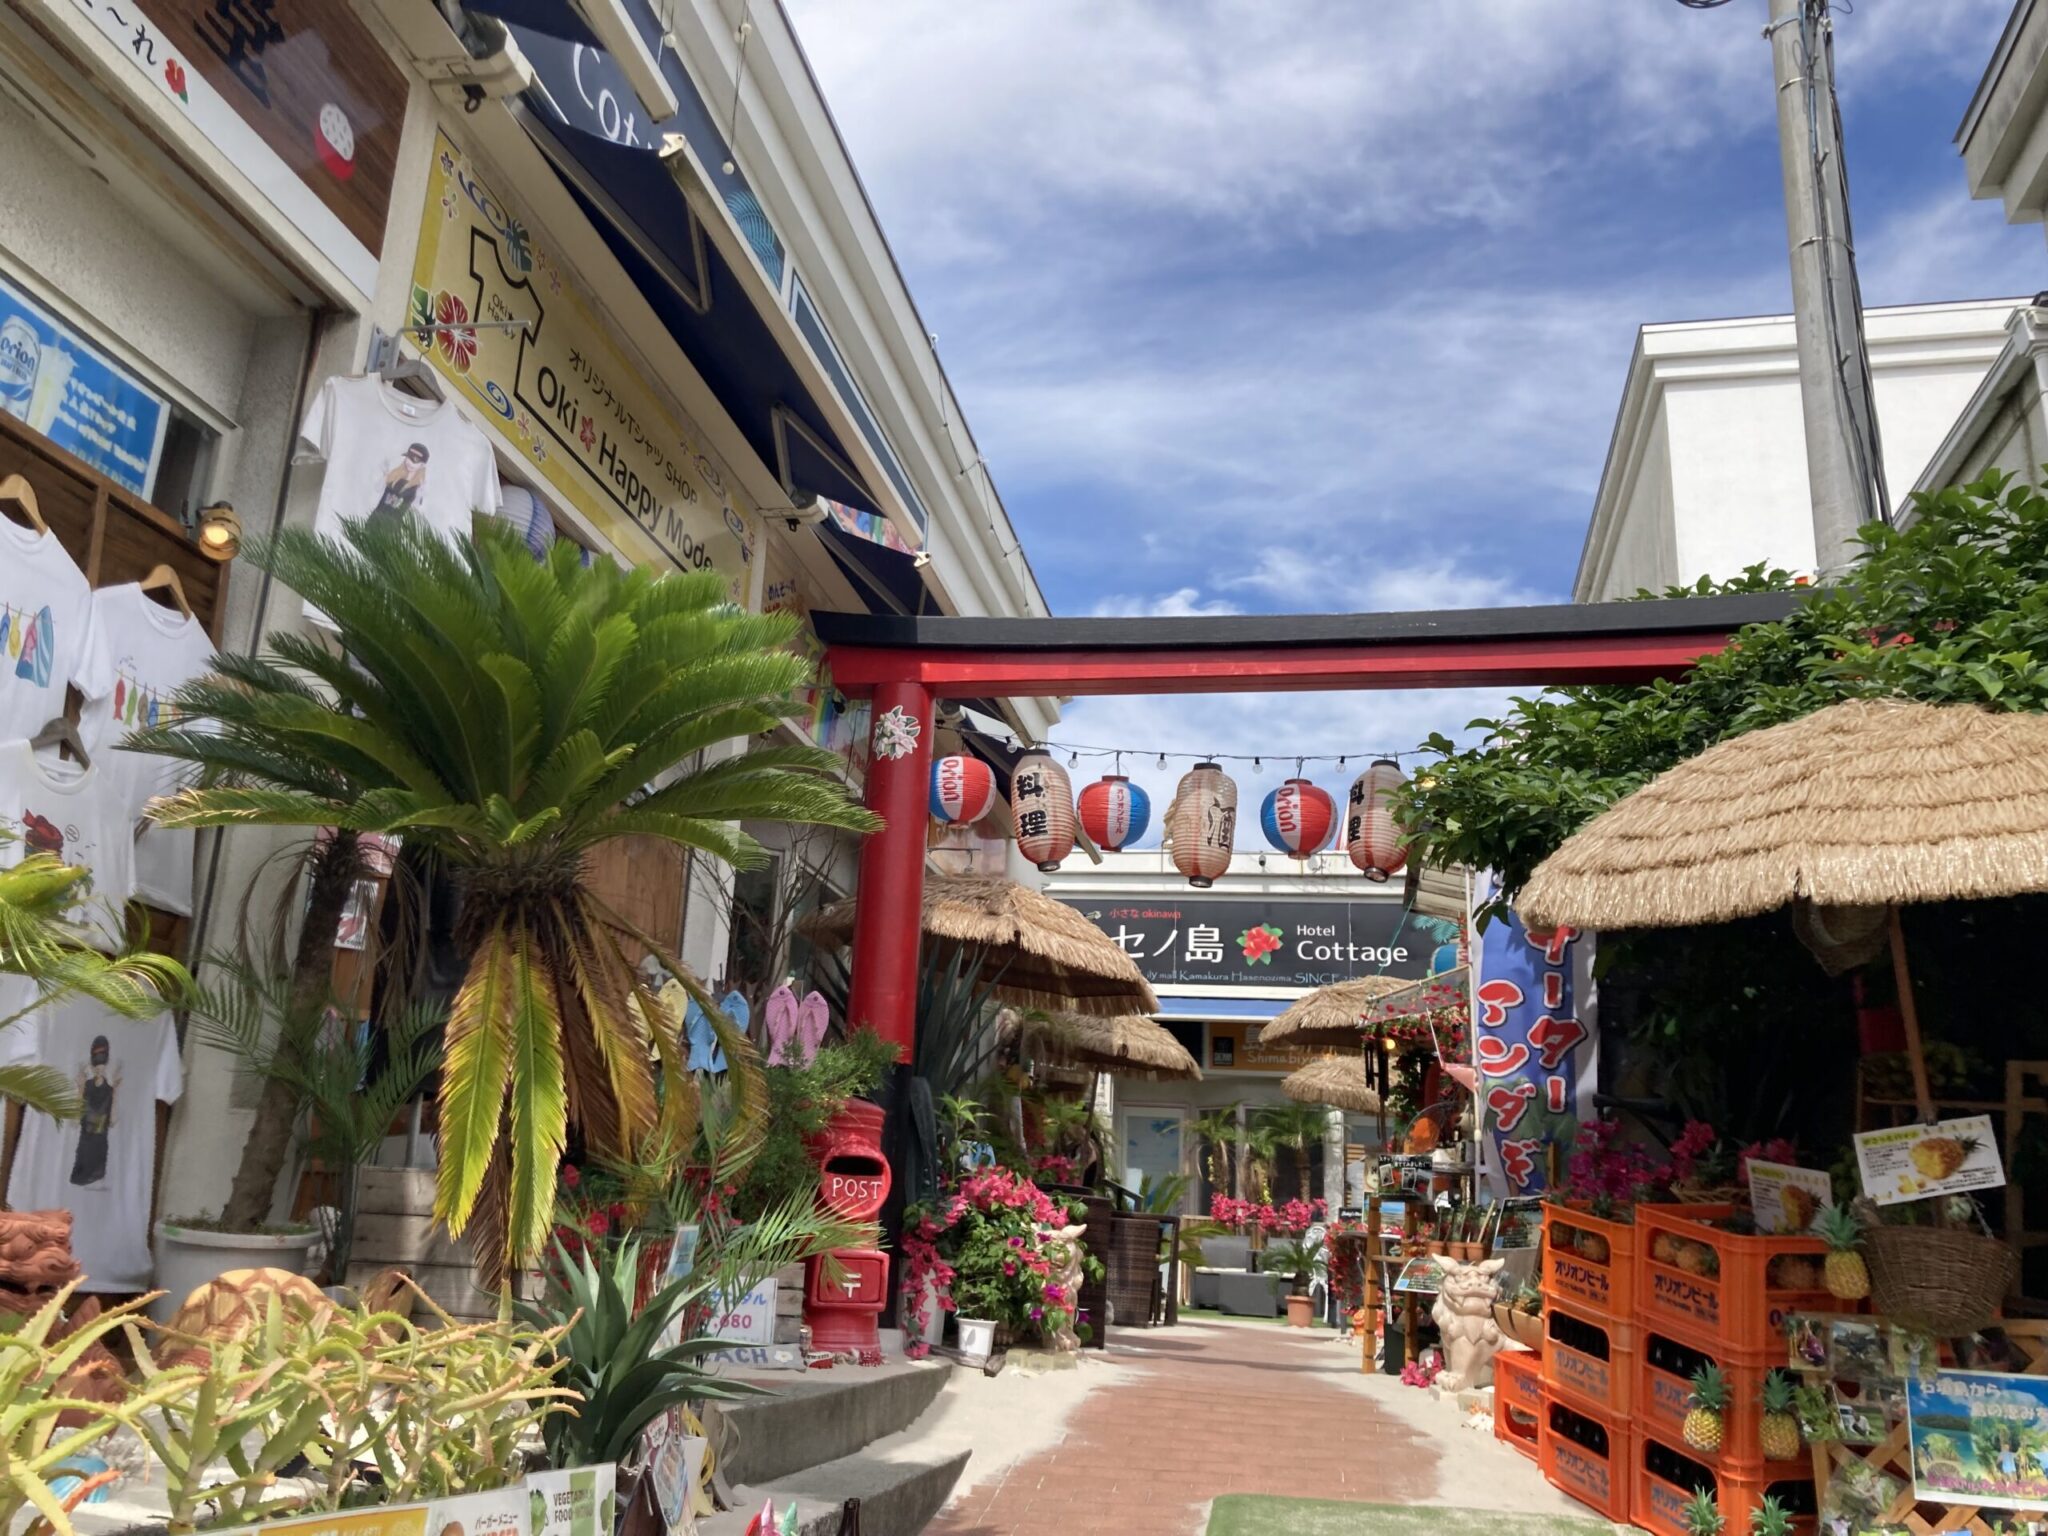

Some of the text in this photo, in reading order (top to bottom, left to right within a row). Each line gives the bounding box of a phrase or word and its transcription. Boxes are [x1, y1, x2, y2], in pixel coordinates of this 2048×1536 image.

[573, 42, 653, 149] Cot
[487, 301, 517, 340] Hay
[492, 293, 509, 318] Oki
[568, 346, 699, 504] オリジナルTシャツ SHOP
[537, 366, 580, 435] Oki
[597, 431, 664, 531] Happy
[941, 759, 963, 803] Orion
[1015, 772, 1049, 838] 料理
[1115, 788, 1125, 834] オリオンビール
[1278, 787, 1299, 833] Orion
[1110, 909, 1182, 919] 小さな okinawa
[1296, 925, 1335, 937] Hotel
[1297, 940, 1408, 967] Cottage
[1179, 971, 1229, 981] Kamakura
[1231, 971, 1292, 982] Hasenozima
[832, 1176, 883, 1200] POST
[1555, 1258, 1610, 1291] オリオンビール
[1654, 1273, 1720, 1310] オリオンビール
[714, 1348, 769, 1364] ACH
